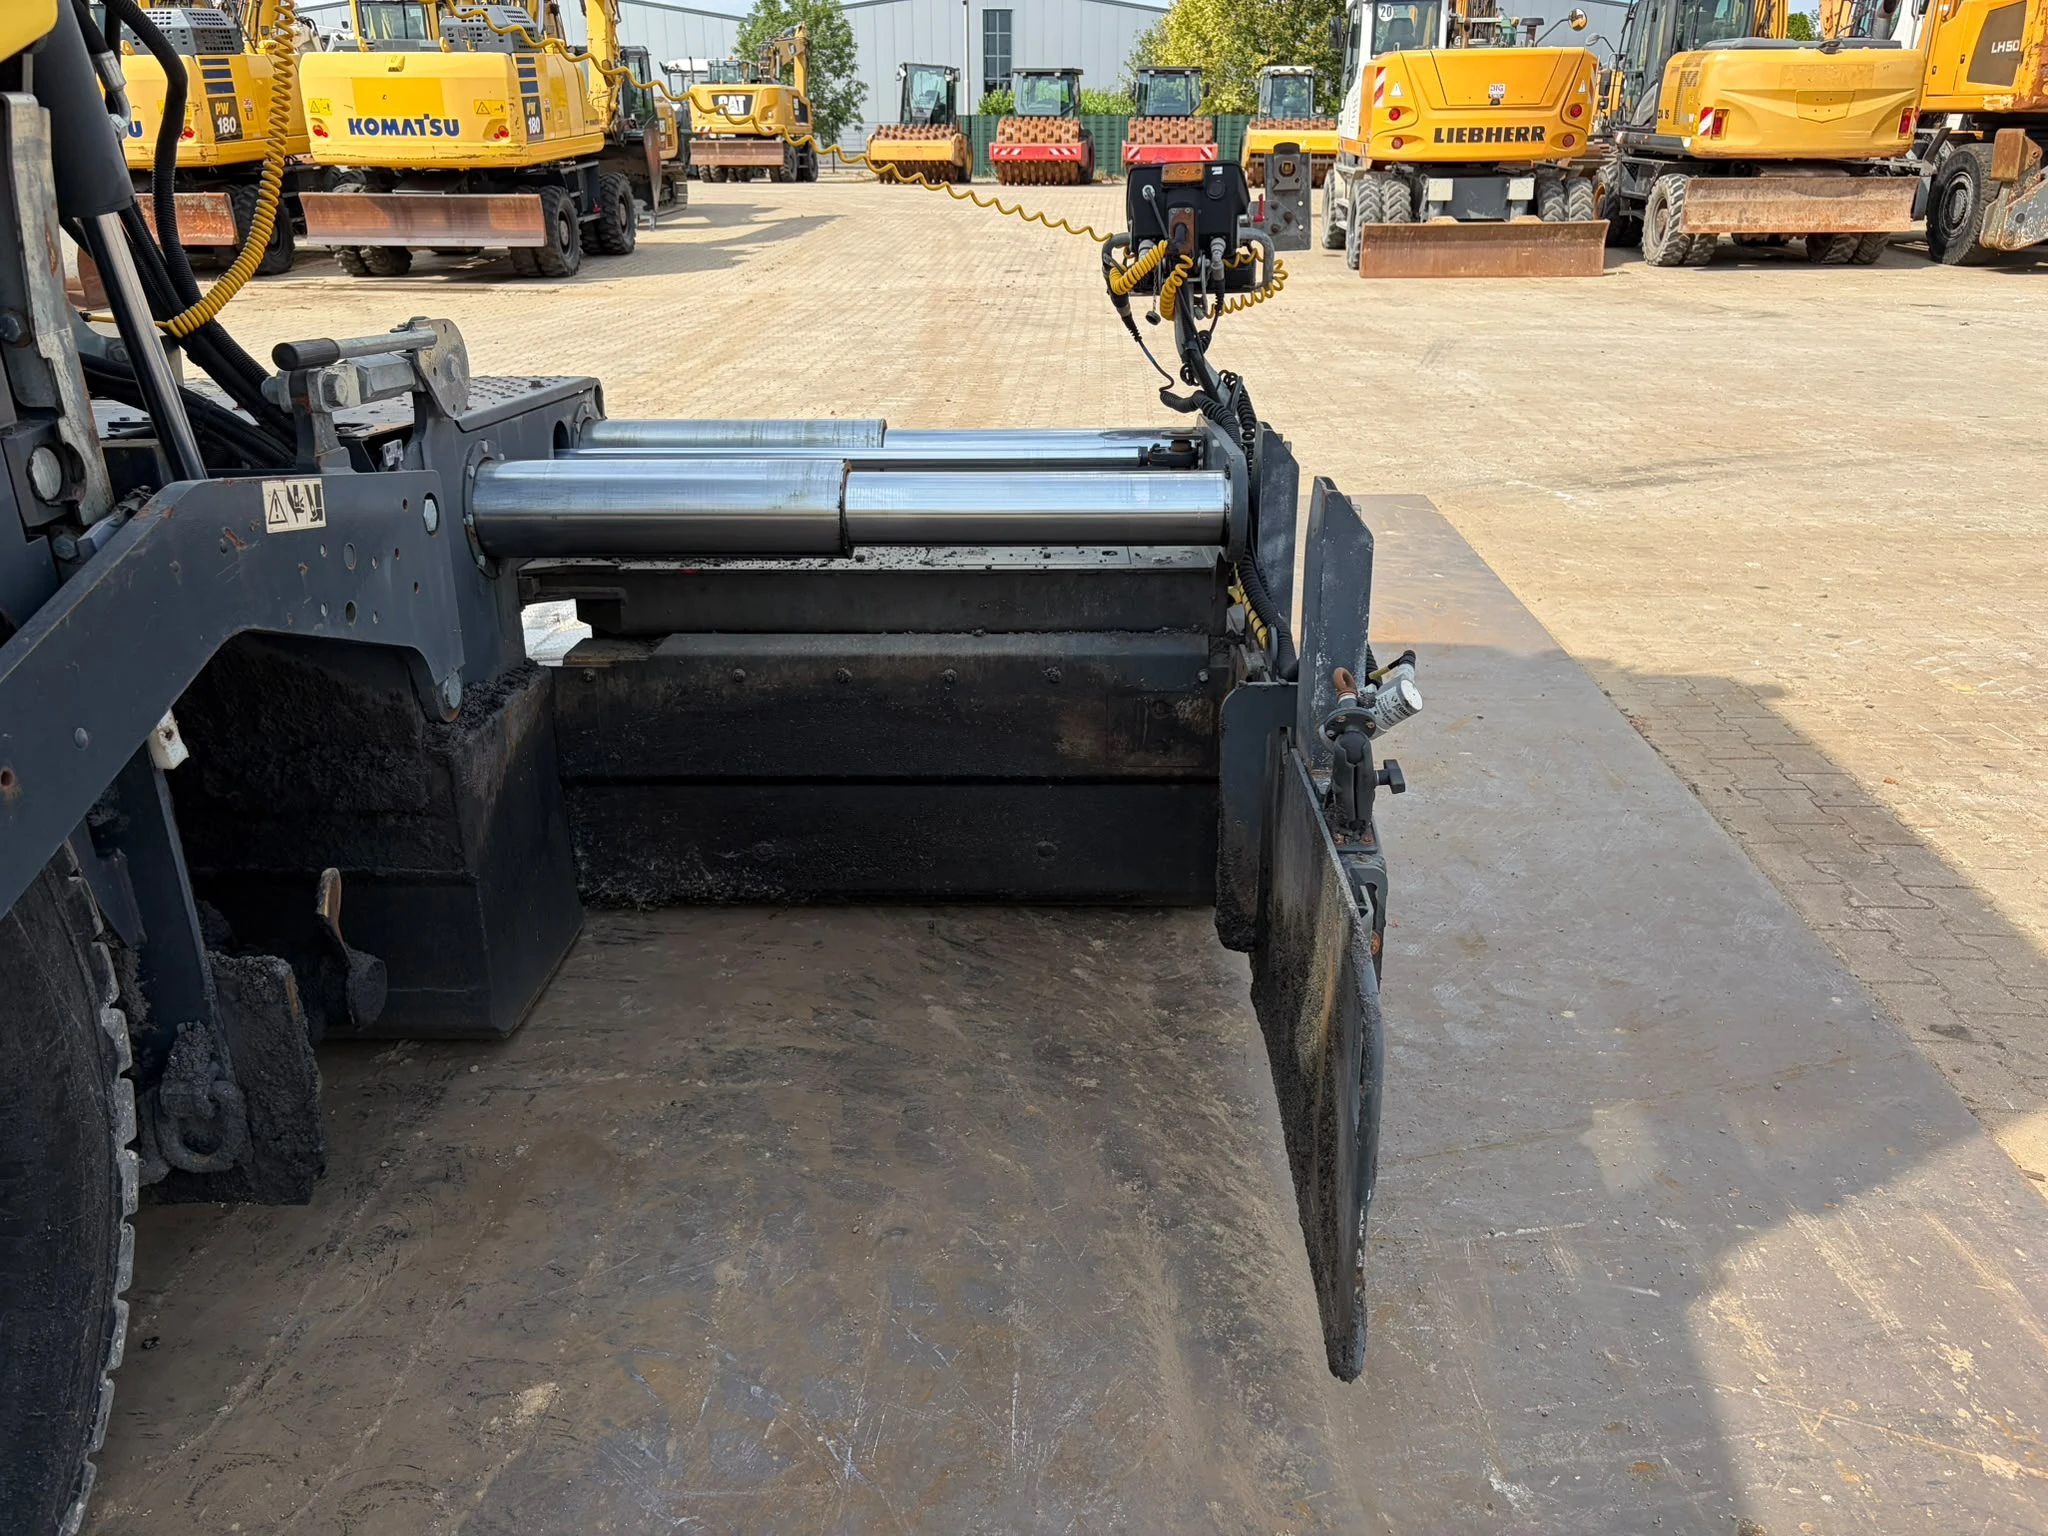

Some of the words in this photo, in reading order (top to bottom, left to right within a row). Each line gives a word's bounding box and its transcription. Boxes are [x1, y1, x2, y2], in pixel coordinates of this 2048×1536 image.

[1380, 6, 1392, 17] 20
[215, 102, 229, 115] PW
[718, 95, 746, 115] CAT
[217, 116, 237, 134] 180
[348, 113, 460, 137] KOMATSU
[528, 116, 541, 134] 180
[1433, 126, 1546, 144] LIEBHERR
